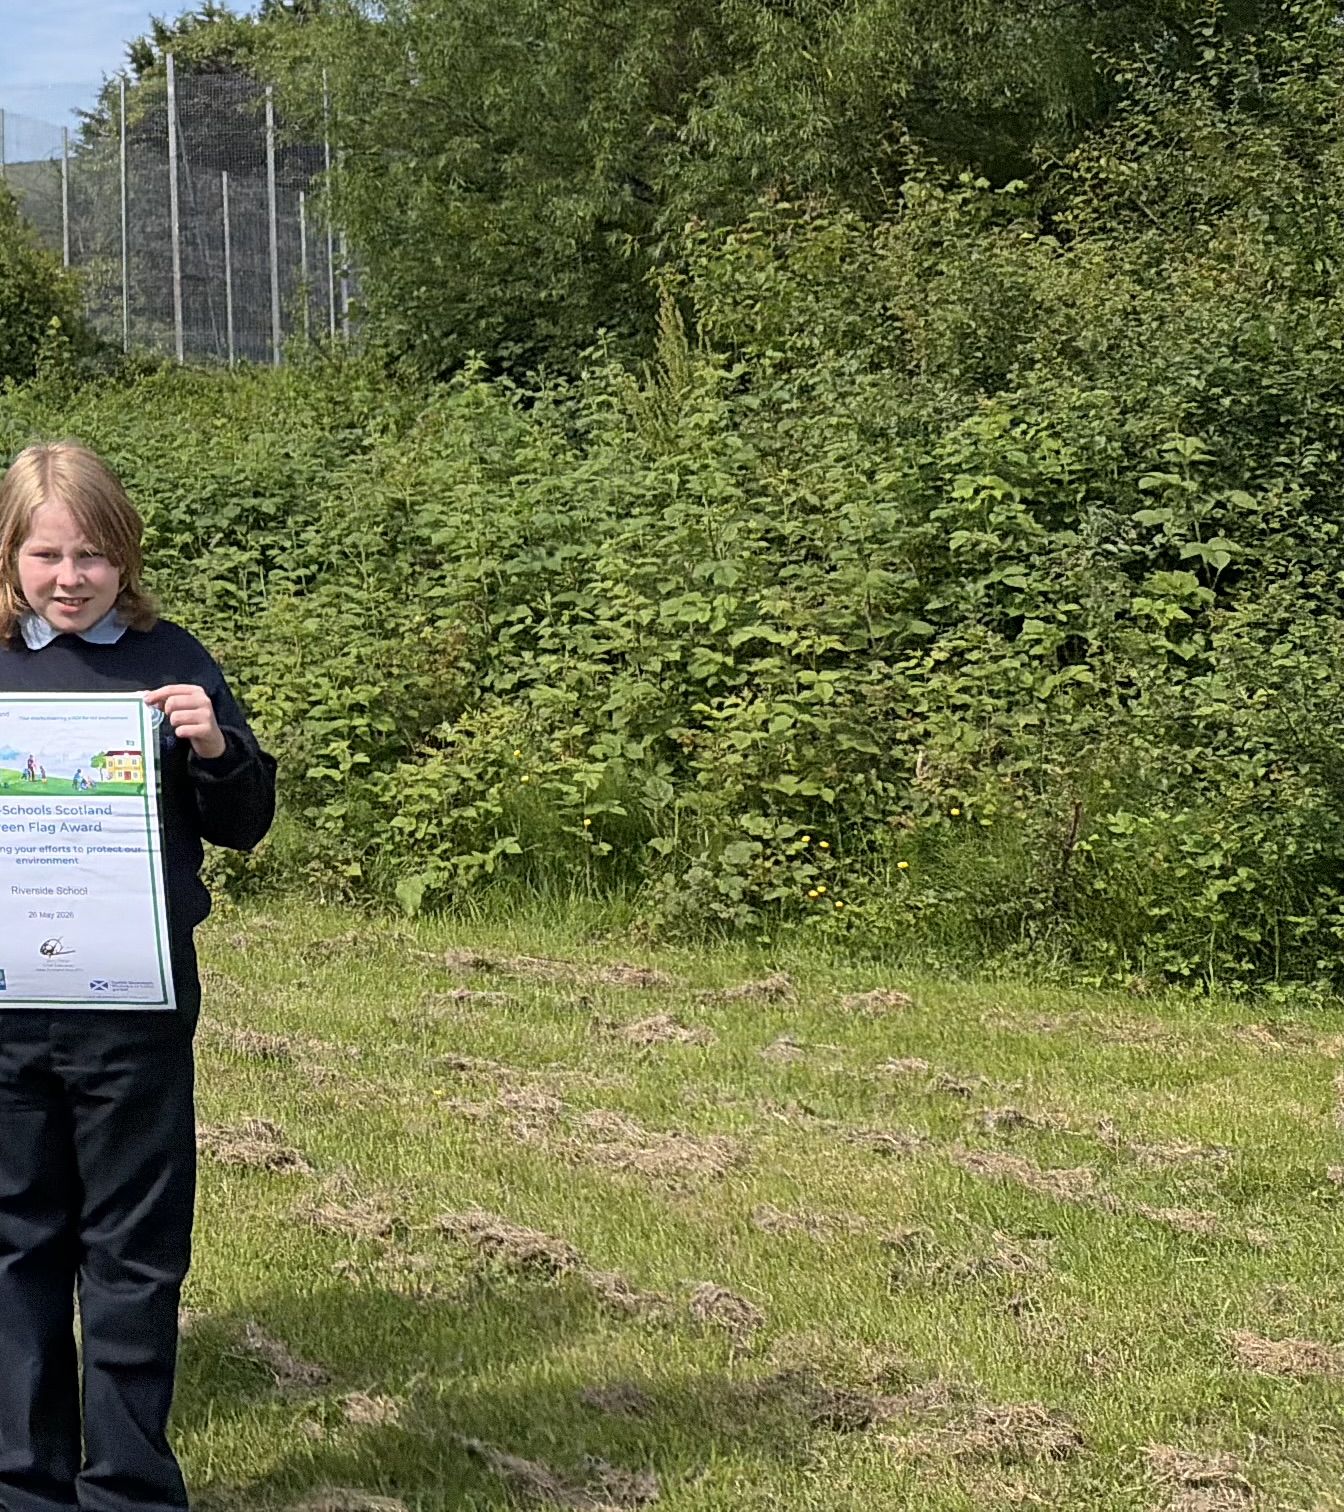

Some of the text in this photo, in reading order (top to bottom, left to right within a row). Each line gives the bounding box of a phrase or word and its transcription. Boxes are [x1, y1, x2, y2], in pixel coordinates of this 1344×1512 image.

[55, 804, 112, 816] Scotland
[28, 822, 56, 835] Flag
[59, 822, 102, 833] Award
[14, 846, 37, 854] your
[39, 844, 71, 853] efforts
[73, 845, 84, 853] to
[86, 845, 122, 855] protect
[15, 856, 79, 865] environment
[11, 886, 88, 896] Riverside School
[39, 911, 54, 920] May
